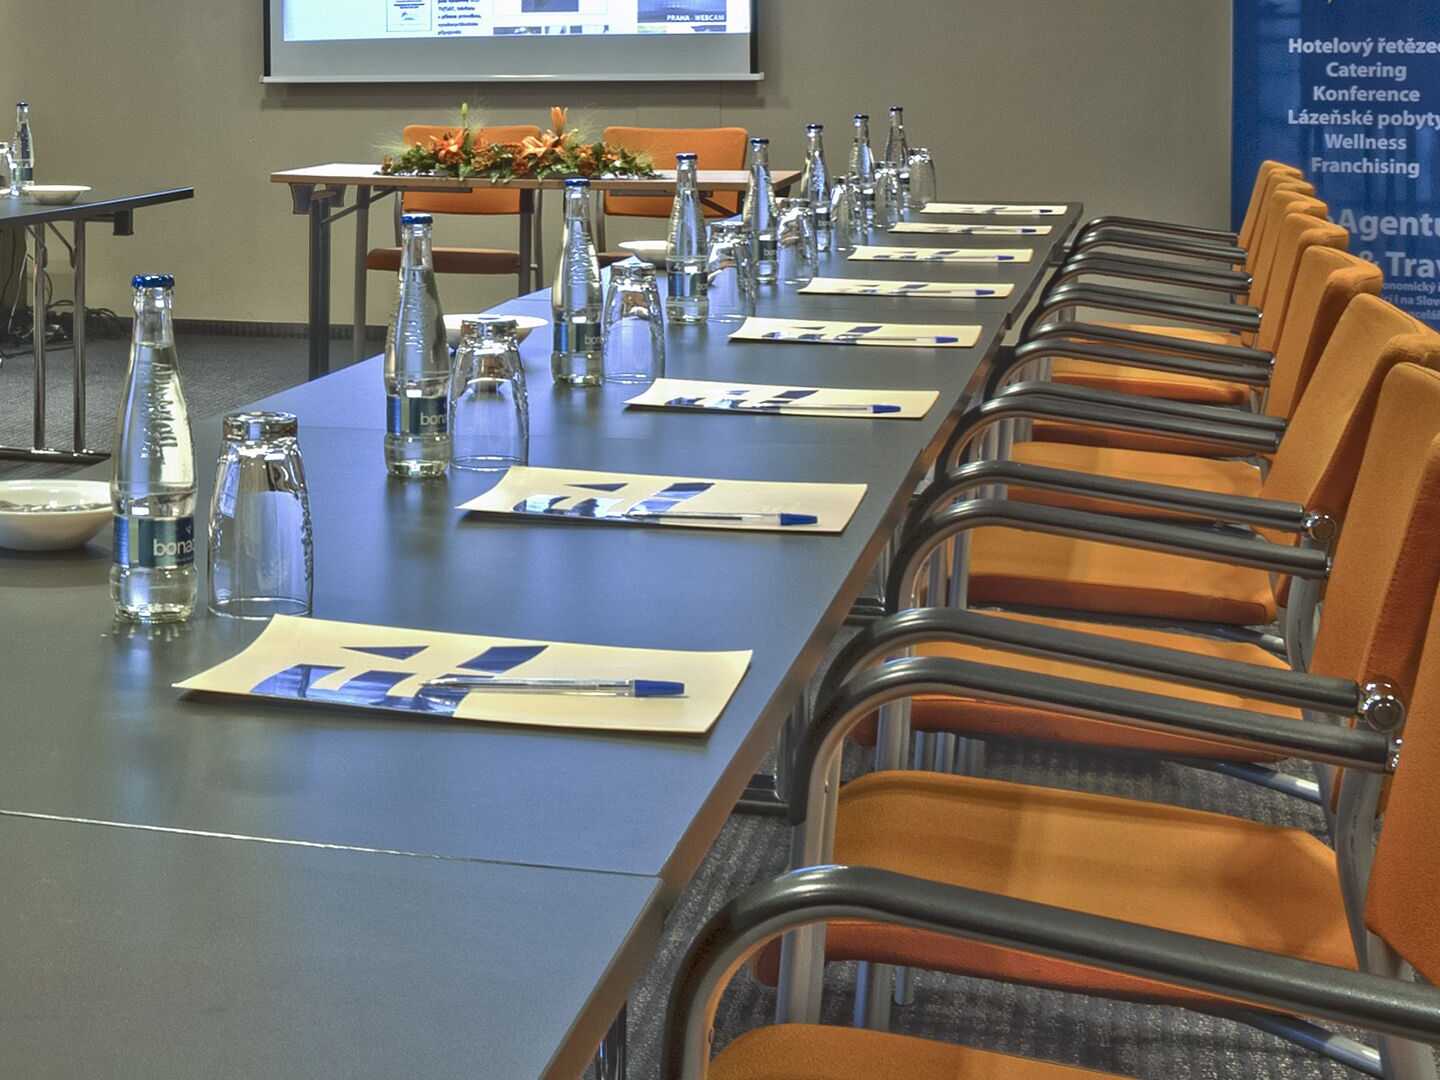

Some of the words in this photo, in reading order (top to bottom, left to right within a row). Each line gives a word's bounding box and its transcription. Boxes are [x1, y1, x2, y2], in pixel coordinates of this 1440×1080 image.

[1288, 37, 1374, 57] Hotelový
[1326, 62, 1407, 81] Catering
[1313, 85, 1421, 102] Konference
[1288, 109, 1373, 125] Lázeňské
[1324, 133, 1408, 150] Wellness
[1311, 156, 1420, 179] Franchising
[1385, 251, 1440, 278] Tra
[153, 538, 195, 557] bona
